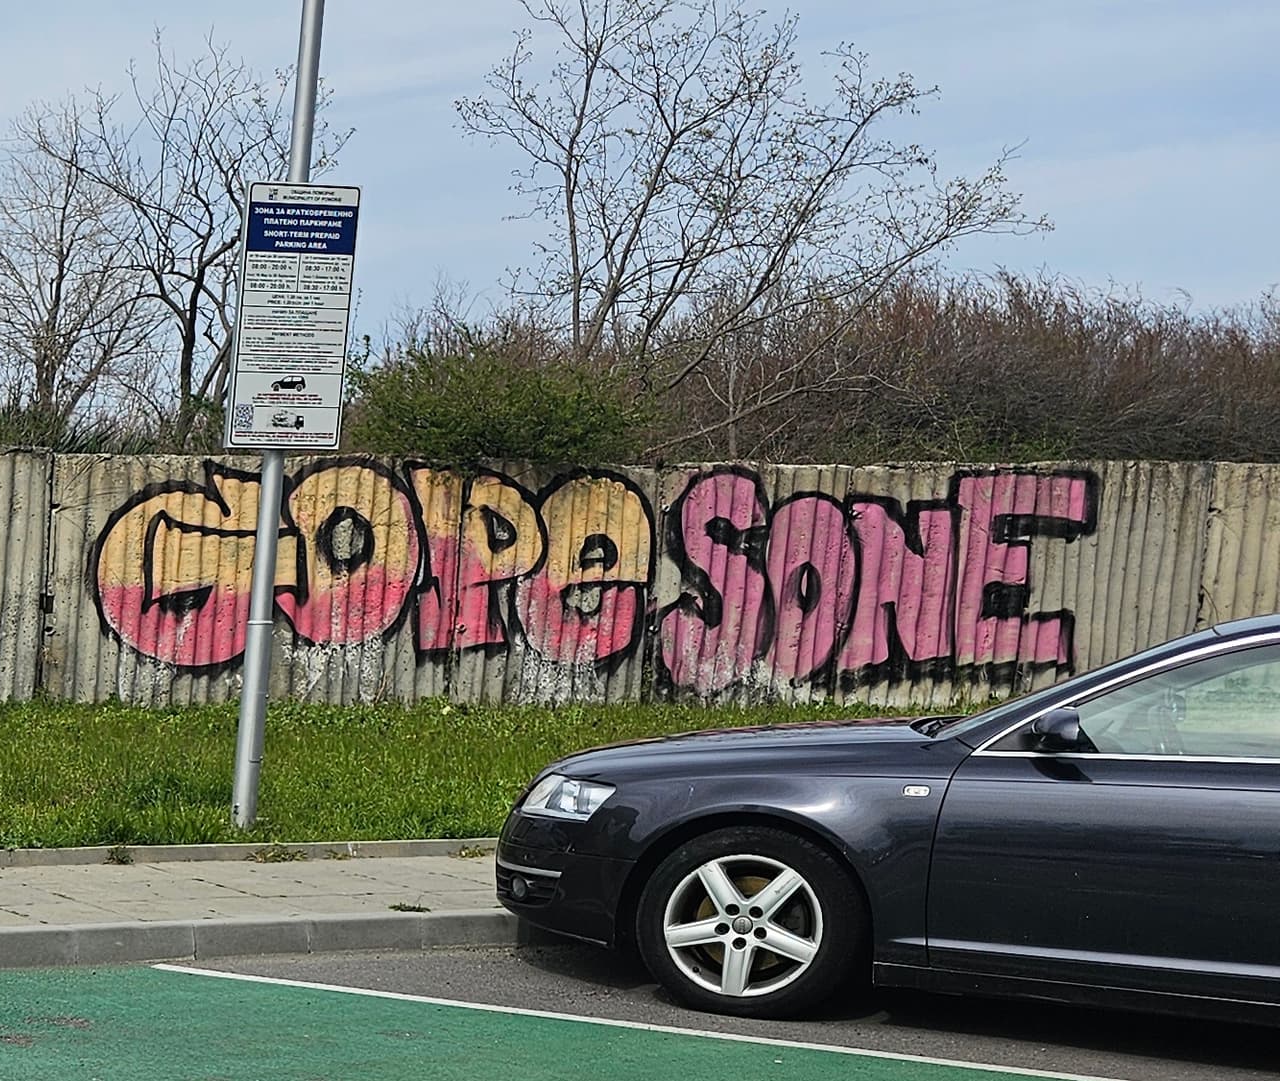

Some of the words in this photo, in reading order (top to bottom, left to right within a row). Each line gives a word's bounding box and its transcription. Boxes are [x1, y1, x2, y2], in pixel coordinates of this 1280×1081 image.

[263, 218, 298, 226] ПЛАТЕНО
[300, 219, 342, 227] ПАРКИРАНЕ
[263, 230, 309, 238] SHORT-TERM
[310, 231, 340, 239] PREPAID
[274, 240, 307, 248] PARKING
